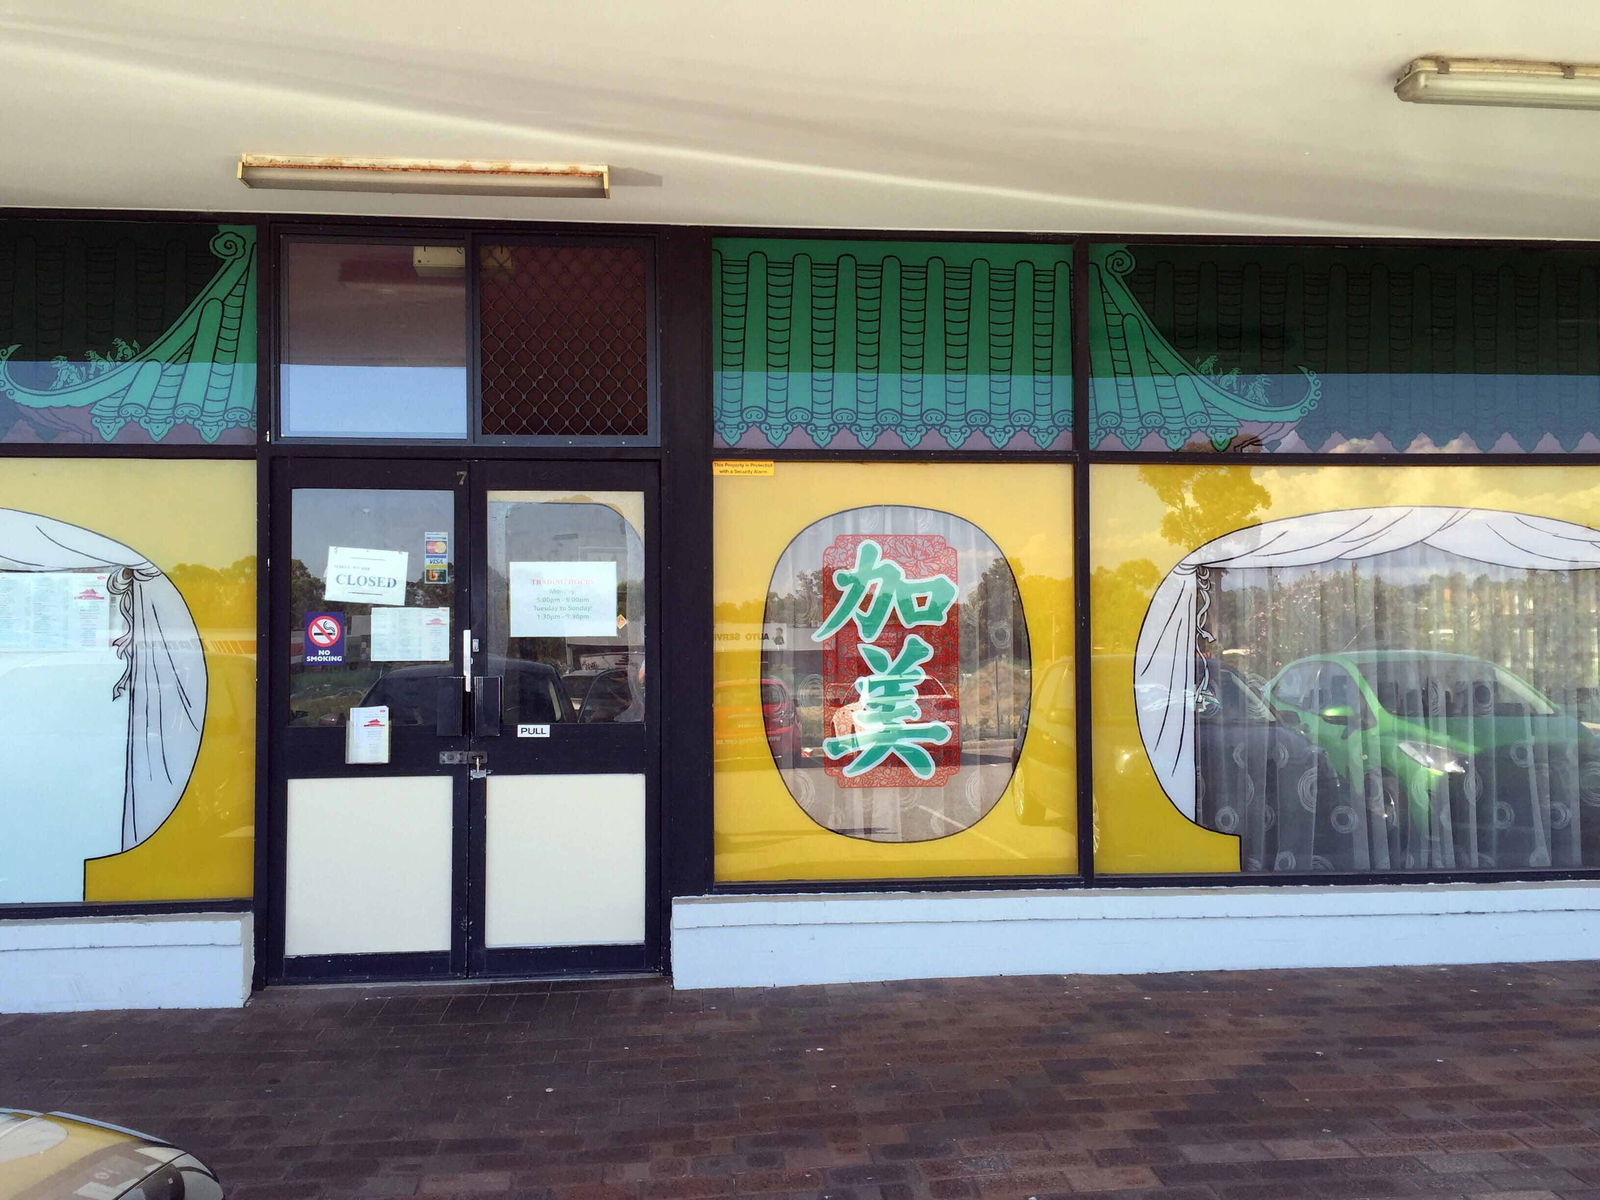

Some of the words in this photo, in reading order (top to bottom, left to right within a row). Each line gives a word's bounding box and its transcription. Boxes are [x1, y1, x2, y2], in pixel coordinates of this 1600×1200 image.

[456, 471, 467, 485] 7
[336, 574, 397, 588] CLOSED
[520, 727, 547, 735] PULL
